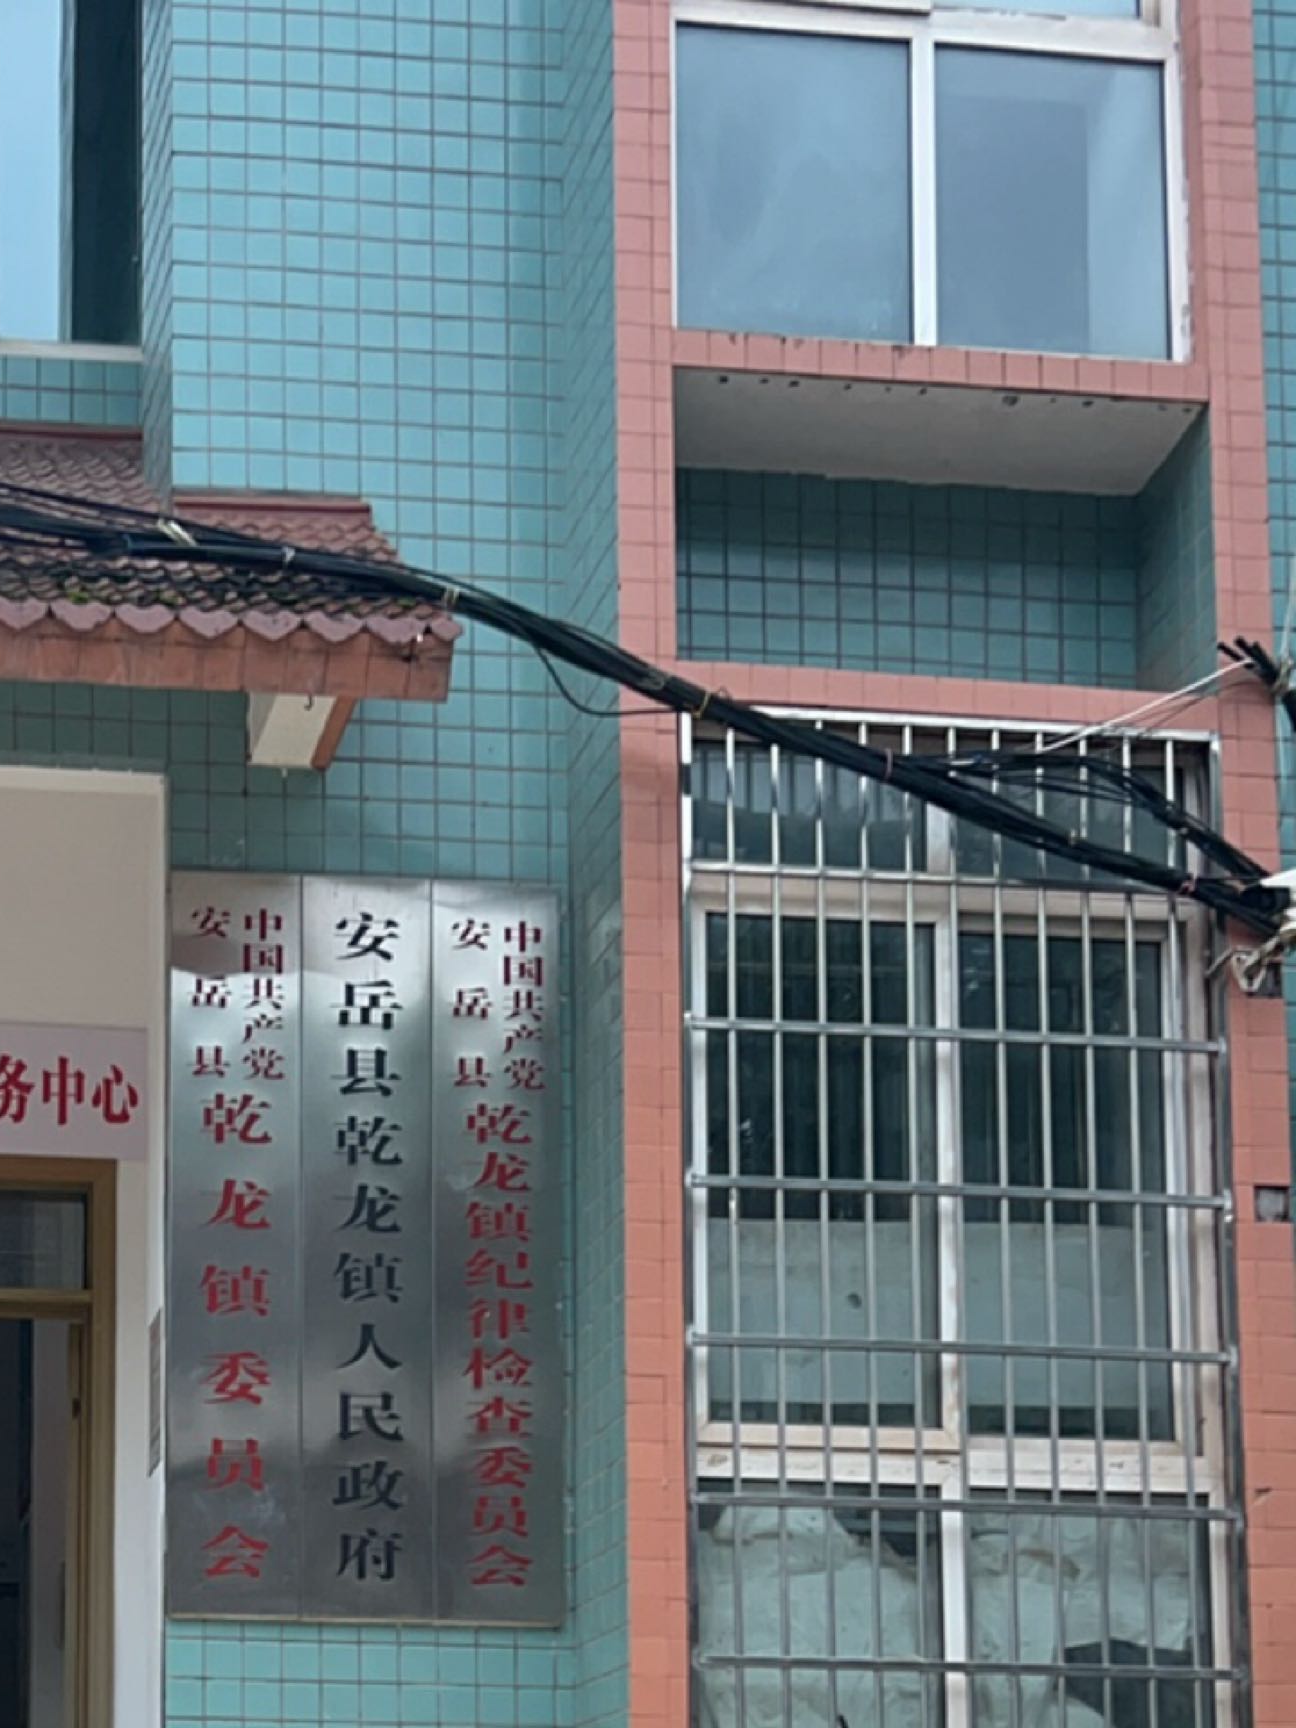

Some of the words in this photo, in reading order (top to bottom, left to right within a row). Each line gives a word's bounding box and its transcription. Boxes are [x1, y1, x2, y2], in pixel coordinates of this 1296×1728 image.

[187, 905, 232, 1078] 安岳县
[242, 907, 285, 1080] 中国共产党
[450, 917, 492, 1090] 安岳县
[503, 919, 546, 1091] 中国共产党
[331, 912, 404, 1582] 安岳县乾龙镇人民政府
[199, 1092, 273, 1580] 乾龙镇委员会
[462, 1102, 535, 1588] 乾龙镇纪律检查委员会
